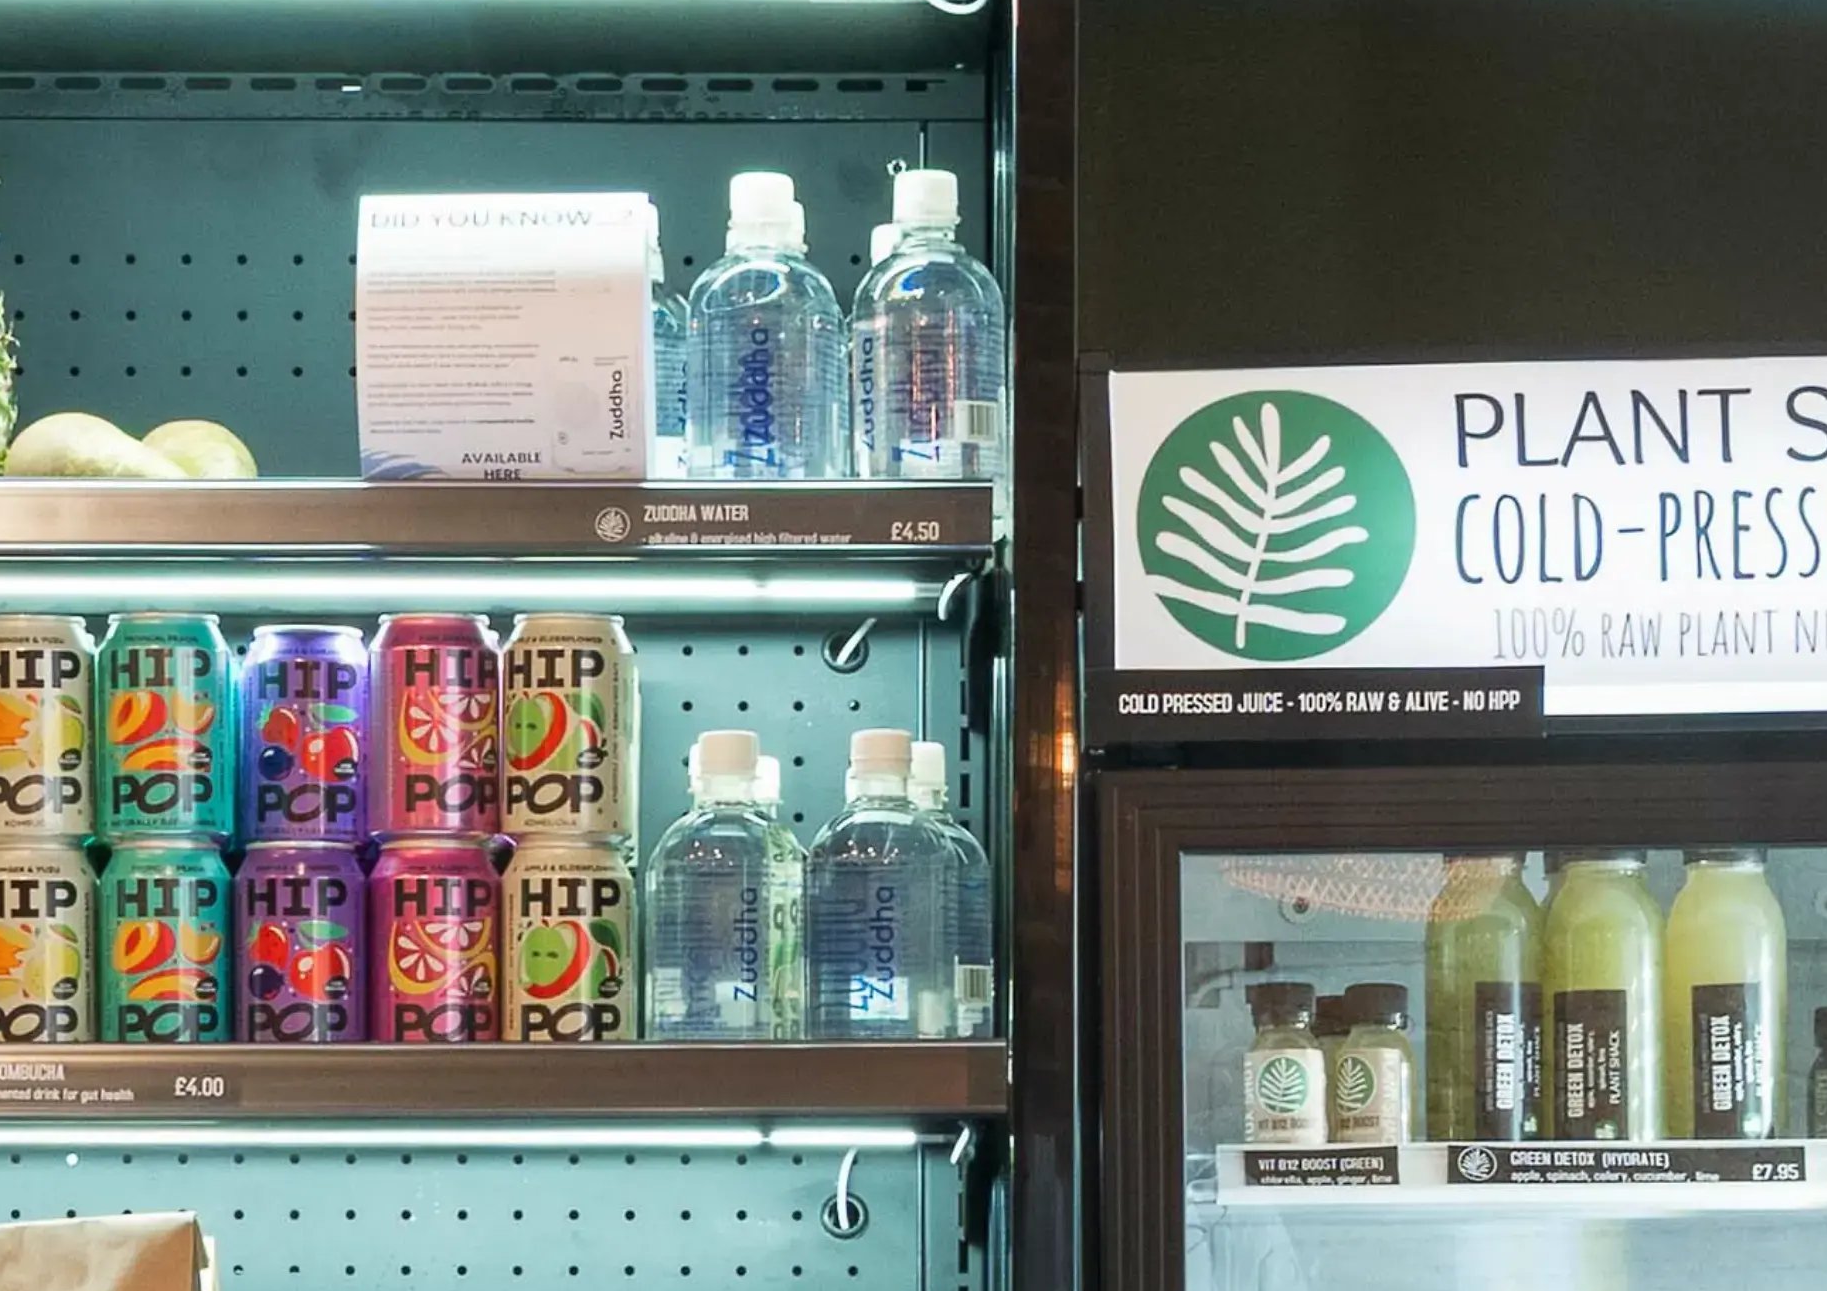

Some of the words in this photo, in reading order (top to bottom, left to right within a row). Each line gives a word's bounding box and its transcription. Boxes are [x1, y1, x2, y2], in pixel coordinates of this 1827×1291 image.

[609, 369, 623, 439] Zuddha
[1454, 387, 1751, 468] PLANT
[461, 453, 541, 464] AVAILABLE
[483, 469, 521, 480] HERE
[644, 505, 696, 522] ZUDDHA
[700, 505, 749, 521] WATER
[891, 521, 939, 541] £4.50
[1492, 606, 1585, 662] 100%
[1599, 612, 1664, 658] RAW
[1677, 610, 1778, 656] PLANT
[508, 650, 604, 689] HIP
[1119, 692, 1157, 713] COLD
[1161, 692, 1232, 713] PRESSED
[1237, 691, 1281, 712] JUICE
[1298, 690, 1340, 712] 100%
[1345, 690, 1384, 712] RAW
[1388, 690, 1400, 711] &
[1405, 690, 1447, 711] ALIVE
[1463, 690, 1483, 710] NO
[1488, 690, 1519, 710] HPP
[507, 776, 604, 814] POP
[734, 887, 758, 1002] Zuddha
[870, 886, 895, 1000] Zuddha
[175, 1077, 224, 1097] £4.00
[1511, 1153, 1551, 1168] GREEN
[1555, 1153, 1594, 1168] DETOX
[1602, 1153, 1670, 1170] (HYDRATE)
[1753, 1164, 1799, 1180] £7.95
